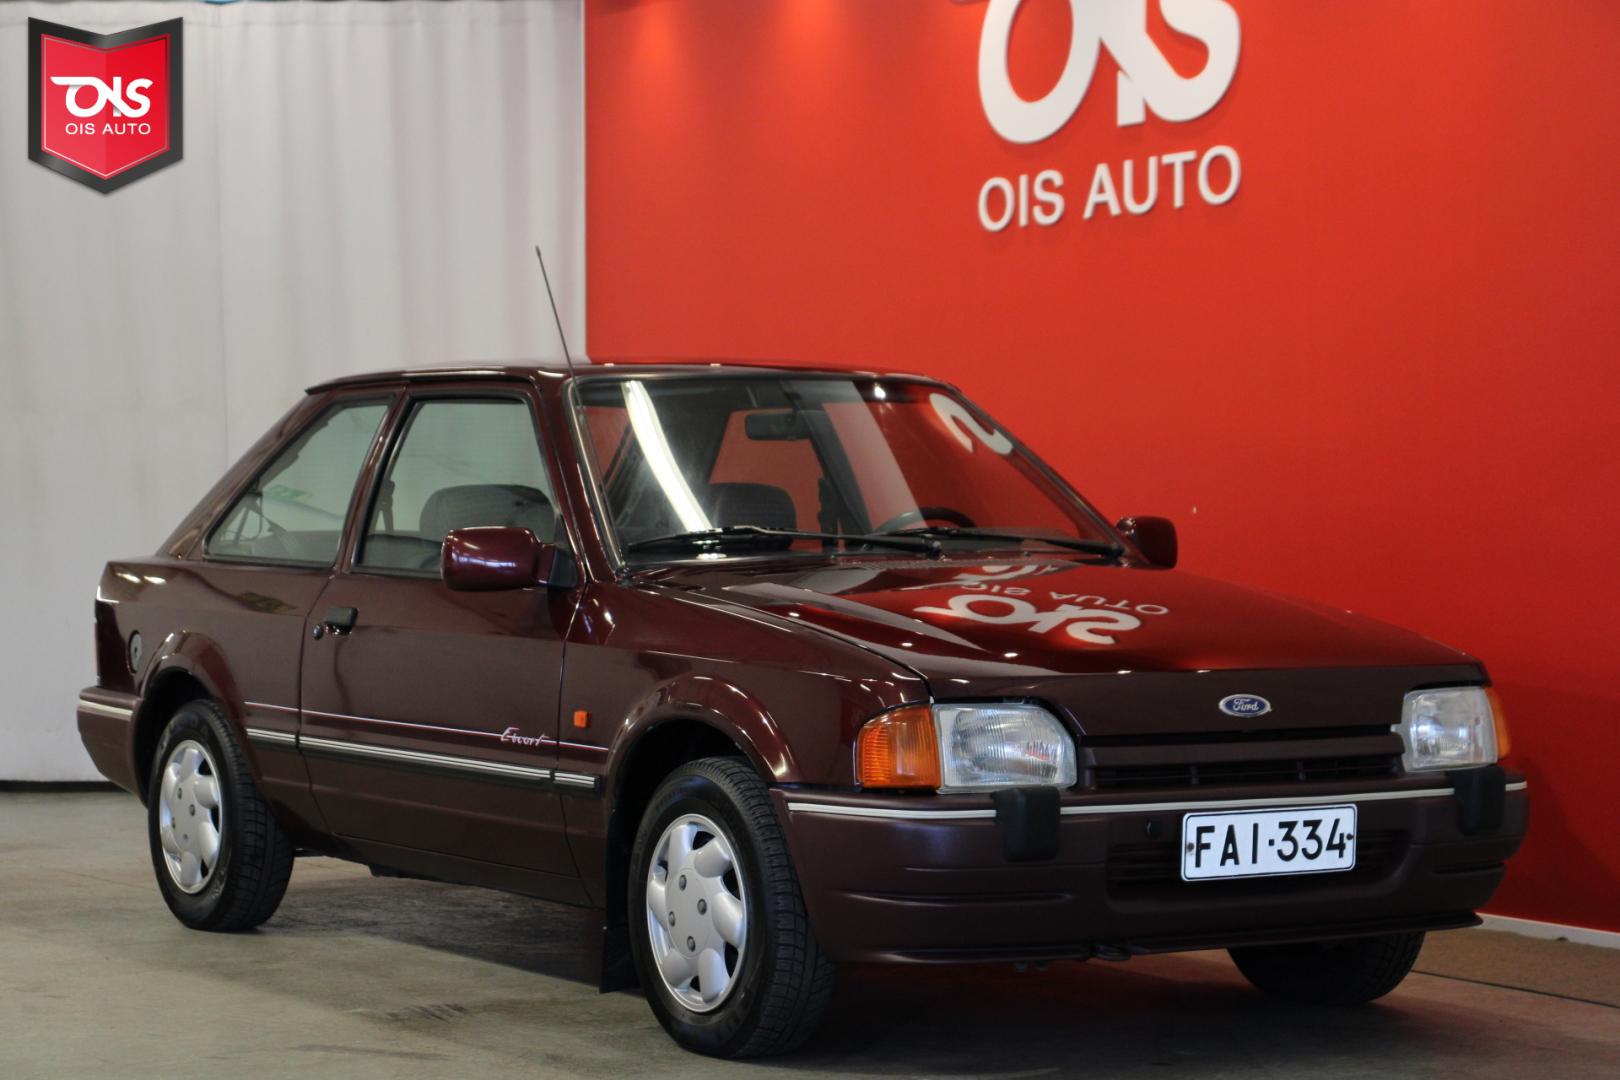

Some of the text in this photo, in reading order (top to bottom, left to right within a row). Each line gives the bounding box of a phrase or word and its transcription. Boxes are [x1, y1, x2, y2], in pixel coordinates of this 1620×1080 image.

[978, 145, 1241, 232] OIS AUTO
[1232, 698, 1259, 711] Ford
